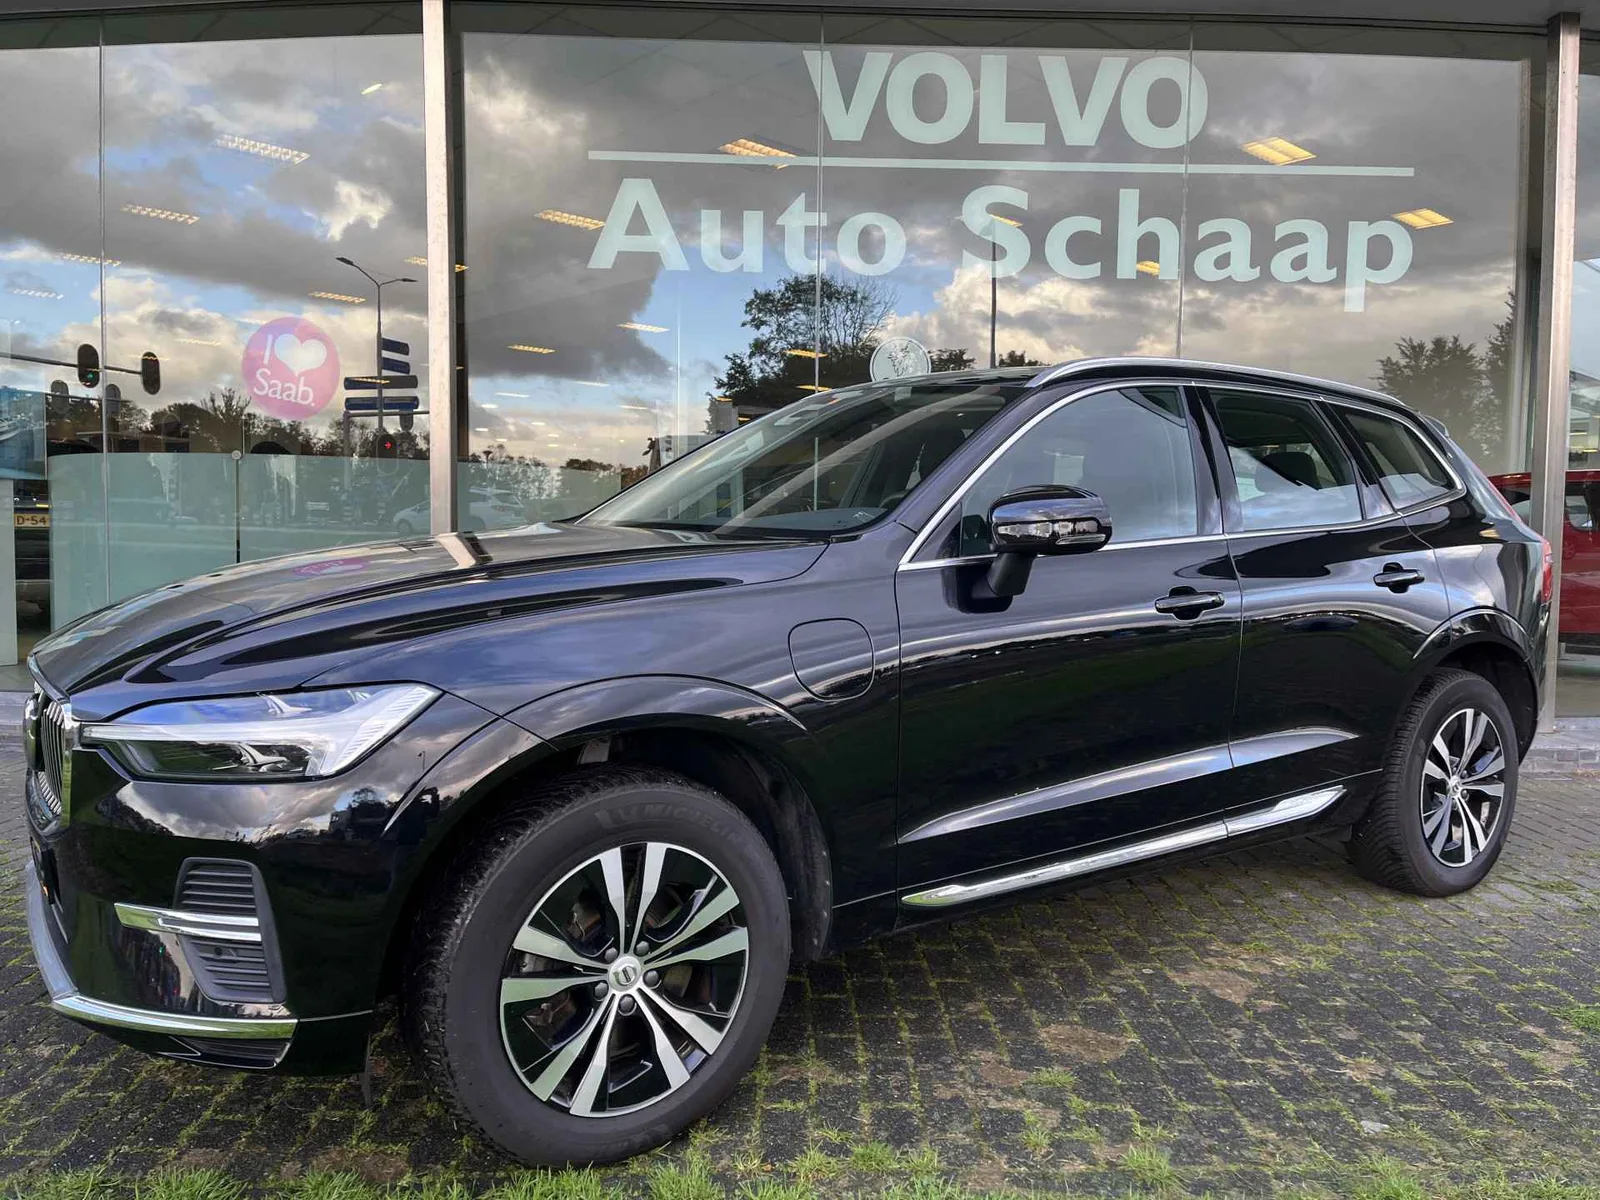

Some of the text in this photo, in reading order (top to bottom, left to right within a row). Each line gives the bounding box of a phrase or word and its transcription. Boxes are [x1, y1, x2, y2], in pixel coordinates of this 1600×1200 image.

[802, 50, 1208, 149] VOLVO
[587, 178, 1414, 313] Auto Schaap
